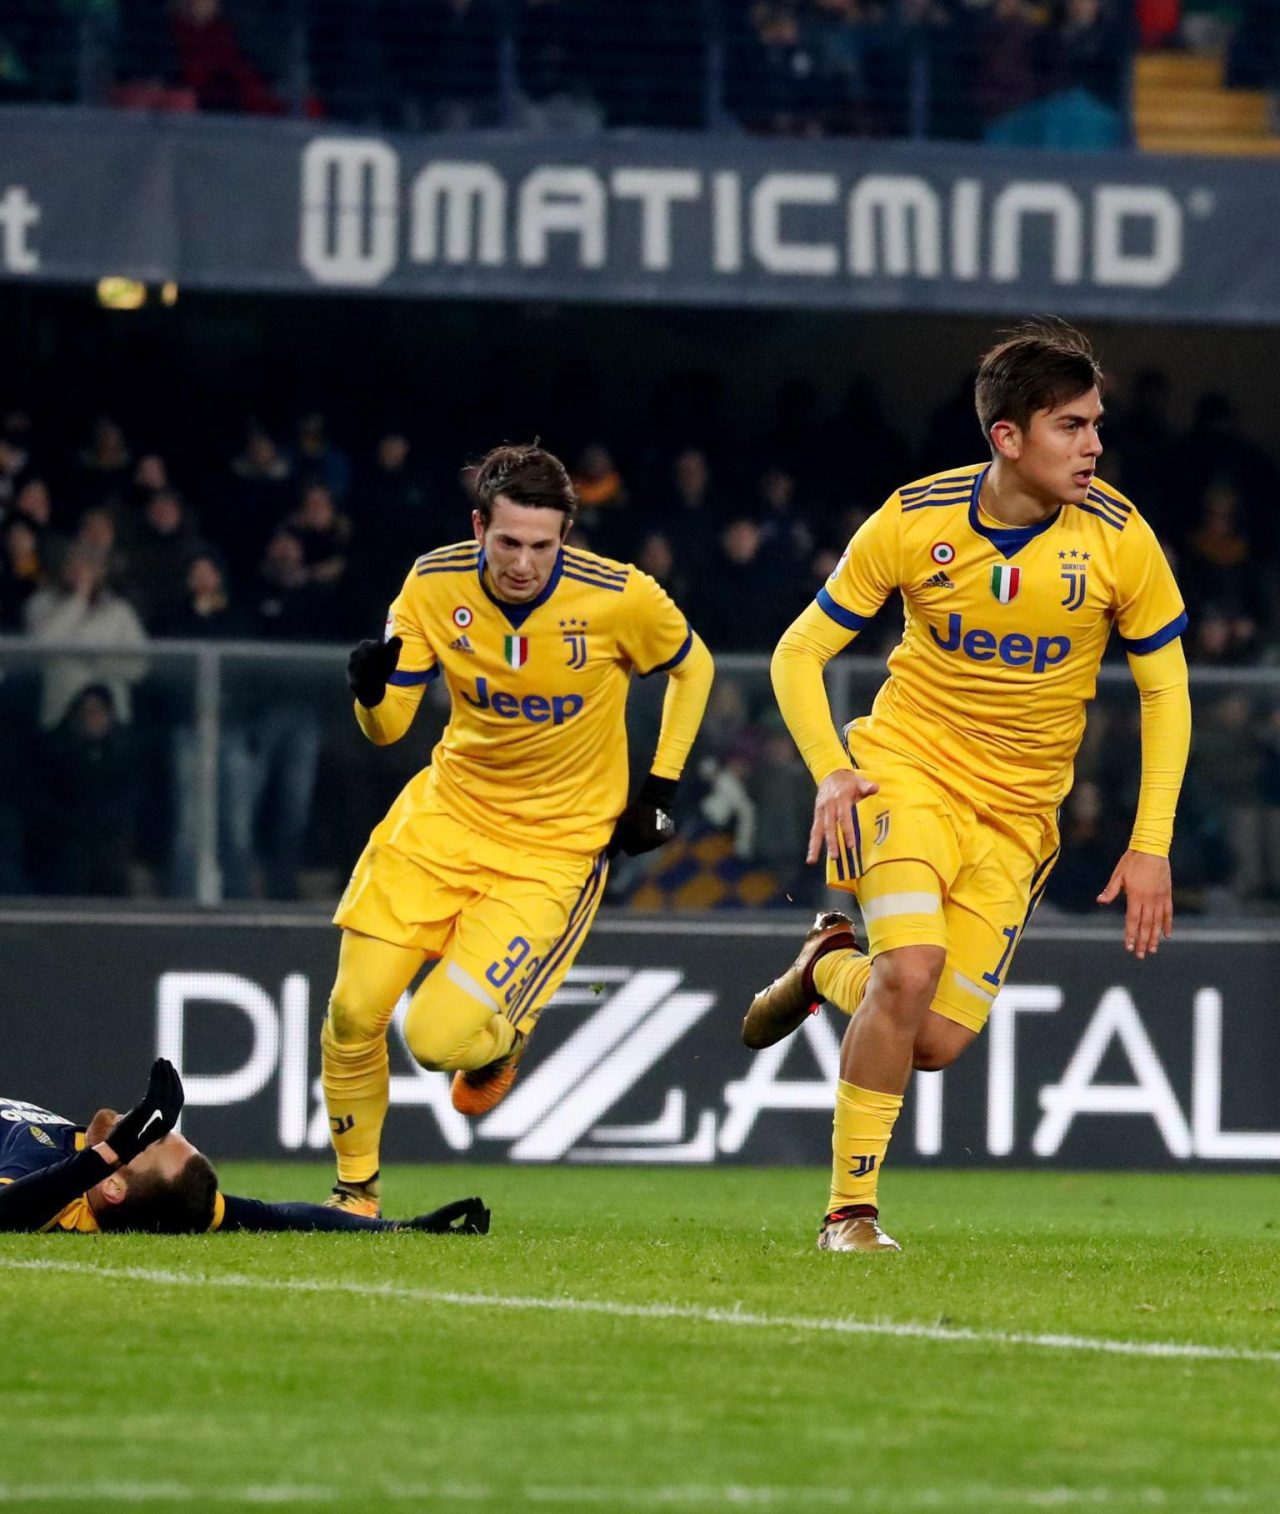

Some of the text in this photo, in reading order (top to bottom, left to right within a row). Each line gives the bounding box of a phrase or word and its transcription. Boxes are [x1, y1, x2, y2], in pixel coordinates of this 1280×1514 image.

[410, 160, 1183, 288] MATICMIND
[929, 612, 1071, 673] Jeep
[461, 676, 584, 725] Jeep
